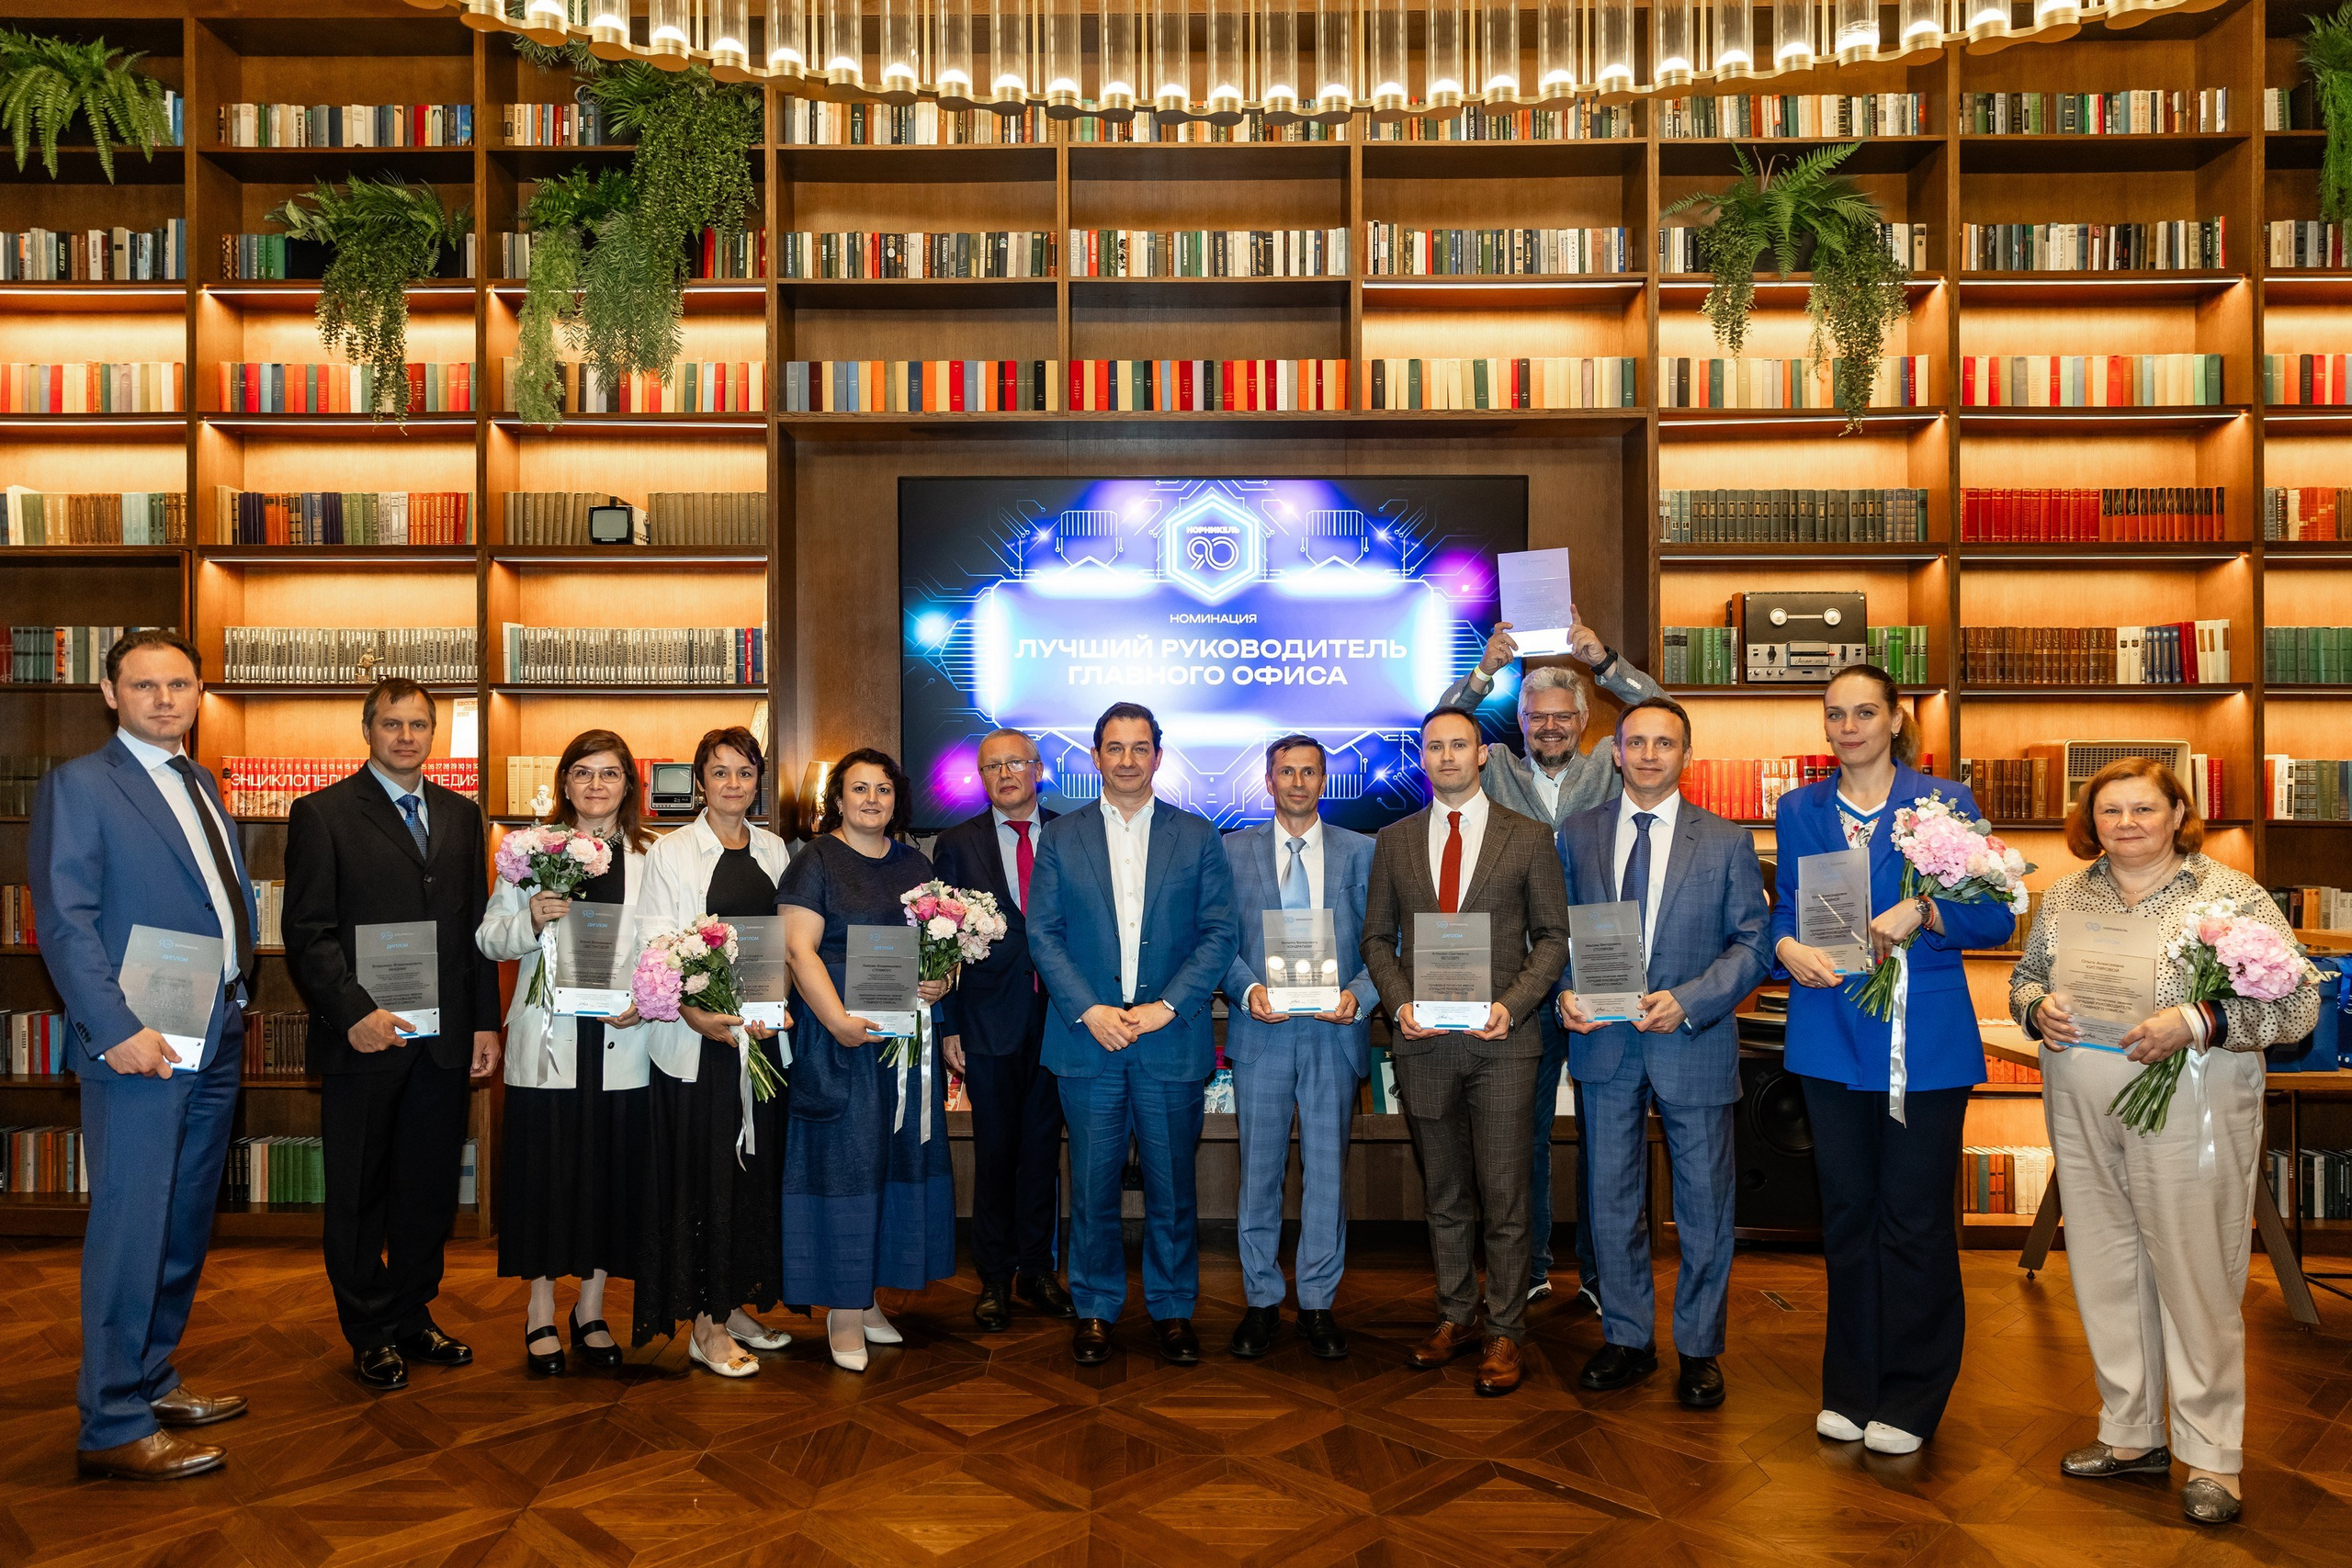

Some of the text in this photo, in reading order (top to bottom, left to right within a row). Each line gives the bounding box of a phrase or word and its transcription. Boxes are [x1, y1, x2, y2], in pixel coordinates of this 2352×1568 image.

[1187, 536, 1239, 571] 90
[1170, 614, 1257, 624] НОМИНАЦИЯ
[1015, 634, 1407, 663] ЛУЧШИЙ РУКОВОДИТЕЛЬ
[1068, 664, 1348, 686] ГЛАВНОГО ОФИСА
